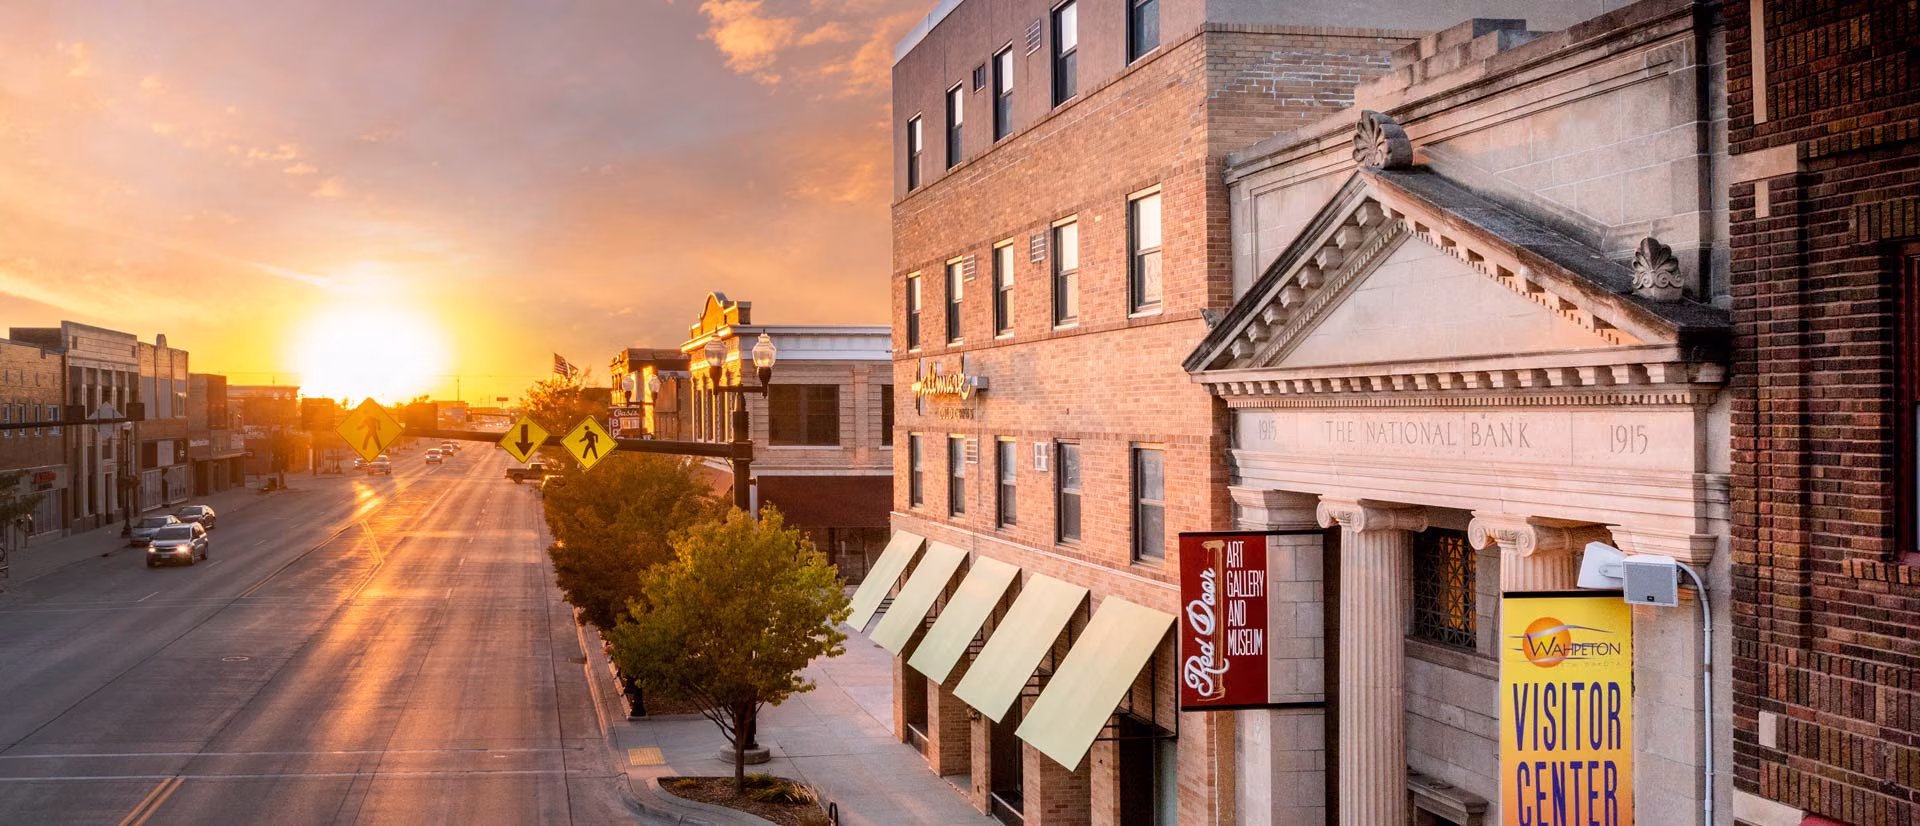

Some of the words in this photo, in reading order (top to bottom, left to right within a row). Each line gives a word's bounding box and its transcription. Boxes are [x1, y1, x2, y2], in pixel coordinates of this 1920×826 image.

[1258, 419, 1277, 441] 1915
[1325, 421, 1355, 443] THE
[1366, 421, 1456, 446] NATIONAL
[1471, 422, 1530, 448] BANK
[1609, 424, 1649, 455] 1915
[1226, 541, 1245, 568] ART
[1226, 570, 1264, 598] GALLERY
[1186, 567, 1216, 636] Door
[1227, 600, 1247, 627] AND
[1227, 628, 1263, 656] MUSEUM
[1526, 633, 1621, 657] WAHPETON
[1184, 637, 1230, 697] Red
[1512, 681, 1622, 751] VISITOR
[1516, 760, 1619, 826] CENTER
